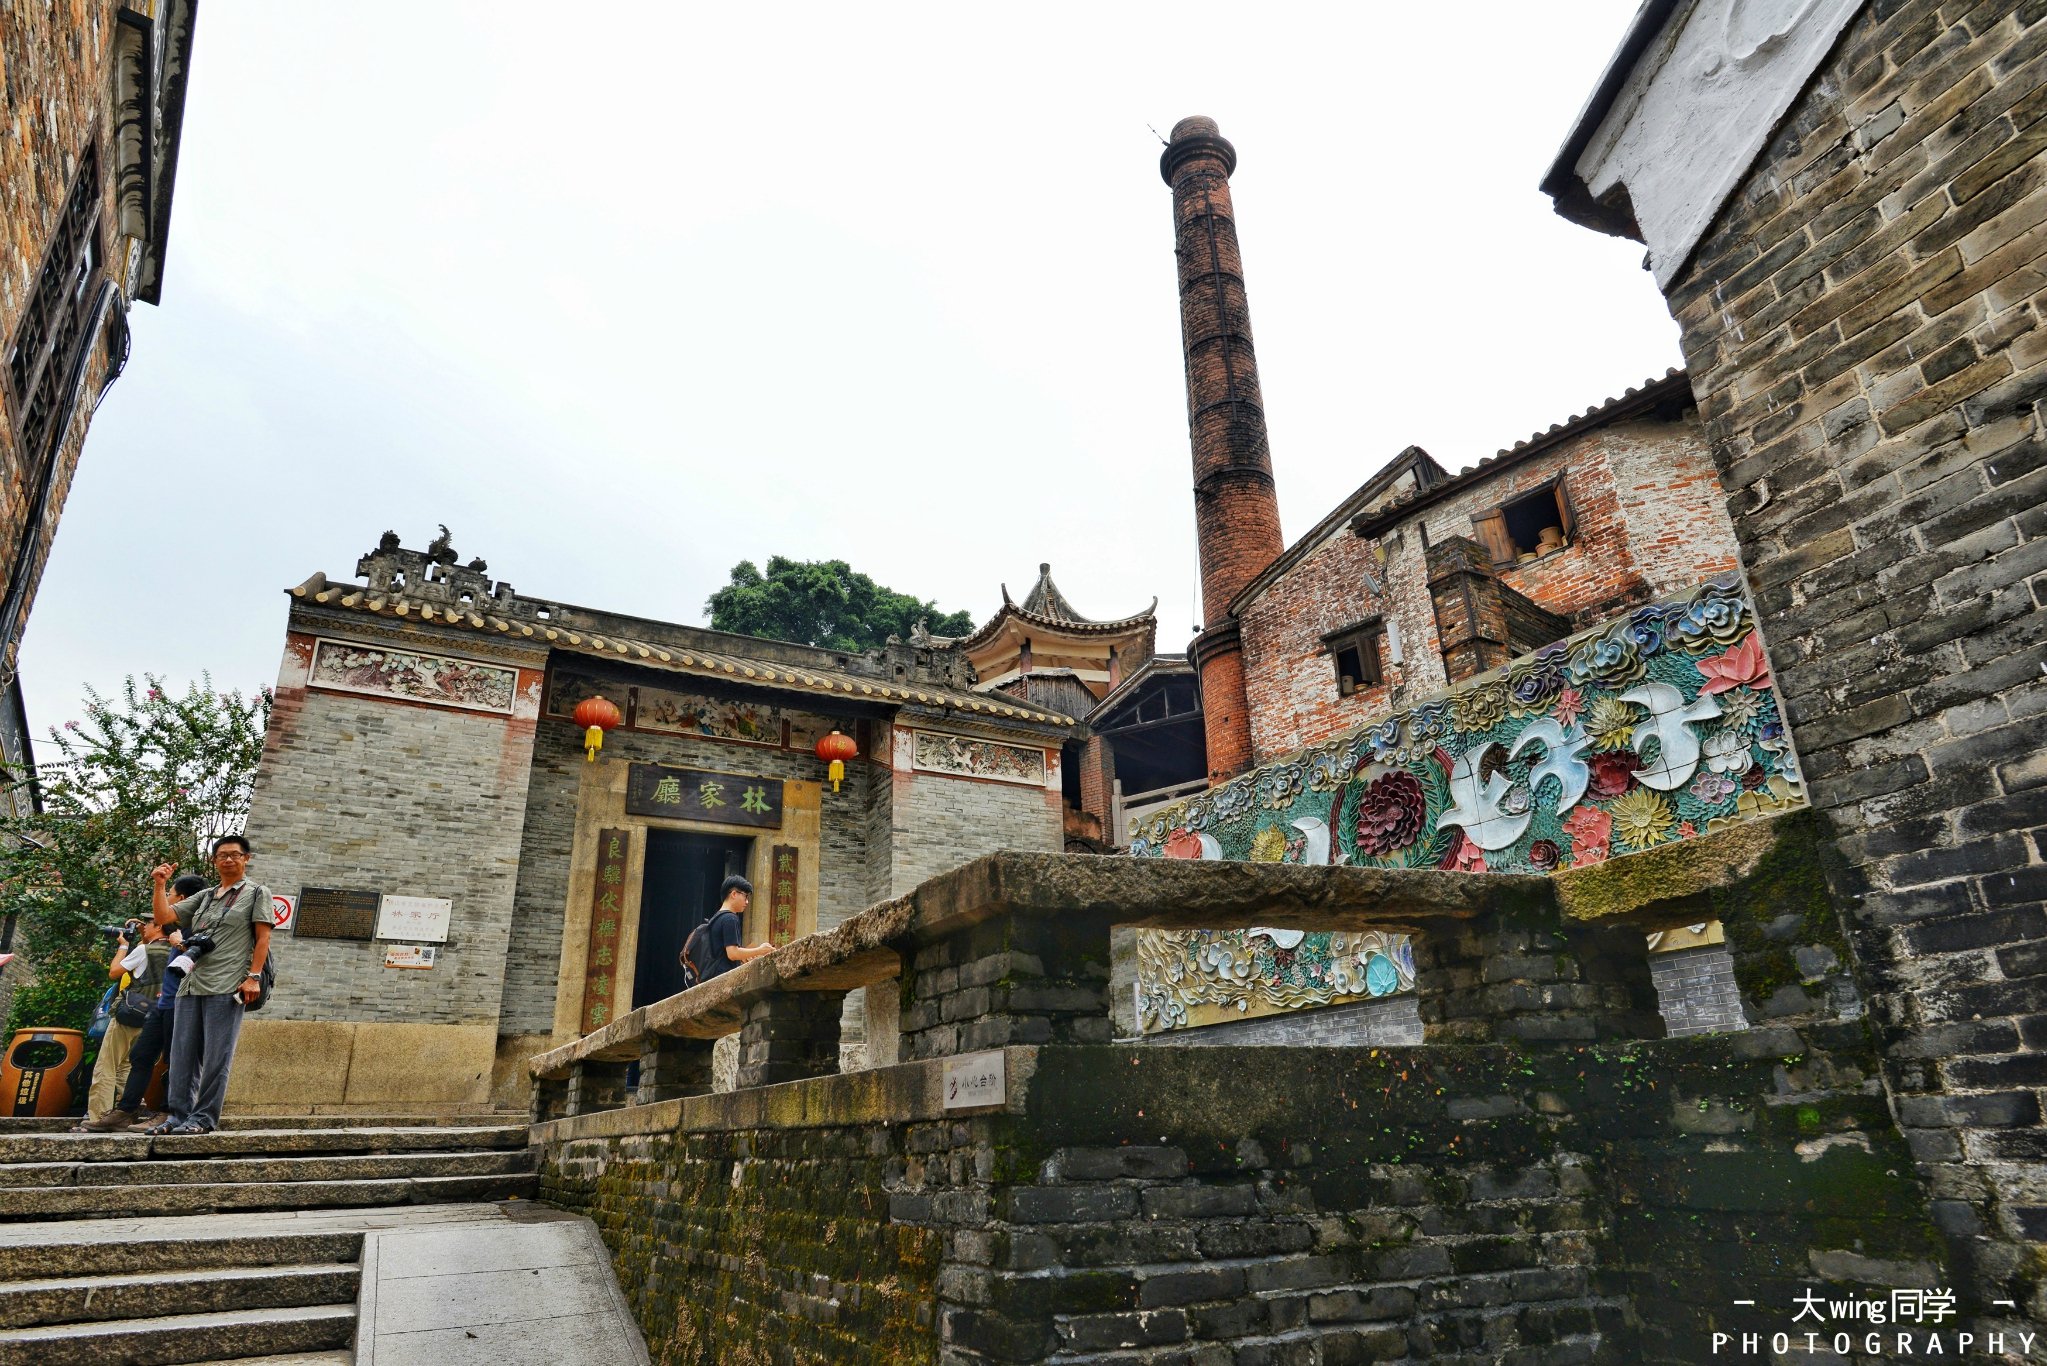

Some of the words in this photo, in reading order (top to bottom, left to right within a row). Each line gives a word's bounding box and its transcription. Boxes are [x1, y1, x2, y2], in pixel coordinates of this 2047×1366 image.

[650, 776, 773, 815] 林家廳
[962, 1074, 996, 1088] 小心台阶
